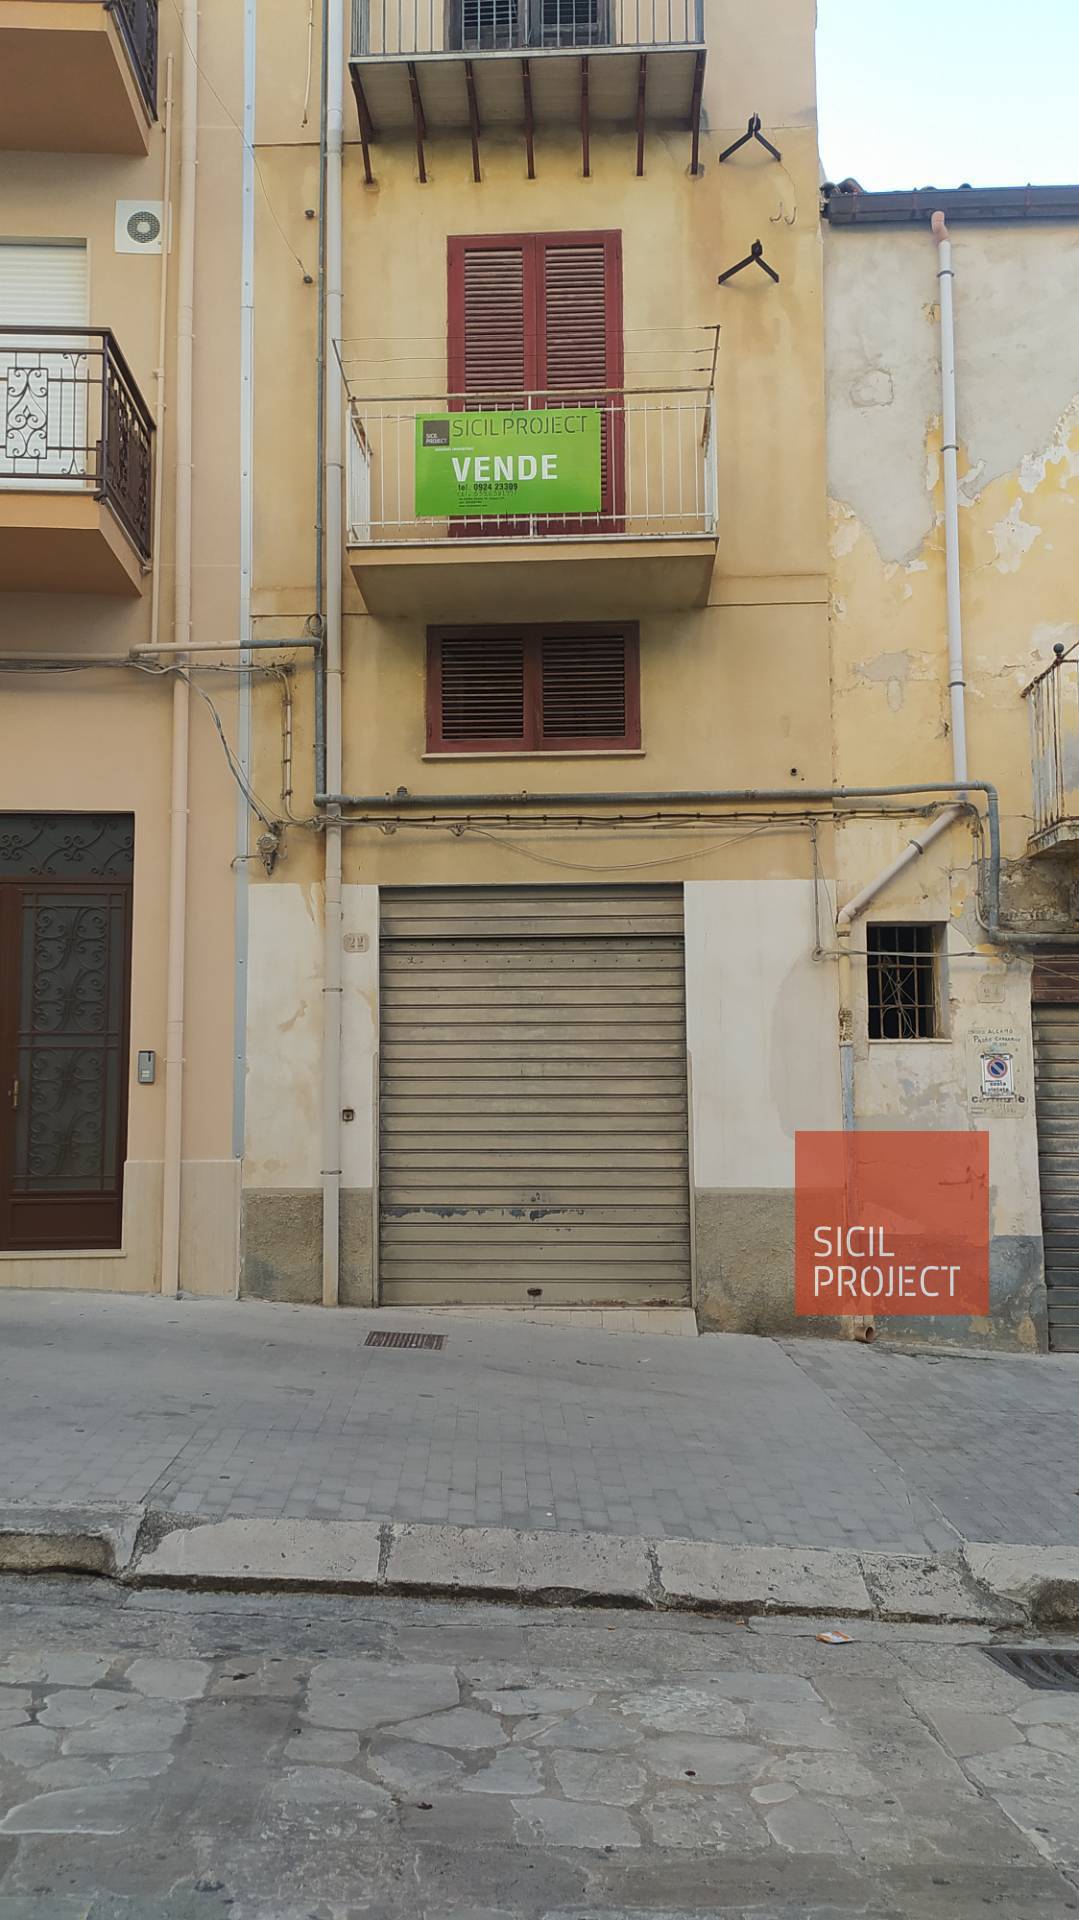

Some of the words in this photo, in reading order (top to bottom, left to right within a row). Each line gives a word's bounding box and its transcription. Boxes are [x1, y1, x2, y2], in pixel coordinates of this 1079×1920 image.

[452, 418, 499, 437] SICIL
[503, 415, 588, 435] PROJECT
[452, 454, 558, 482] VENDE
[473, 483, 492, 491] 0924
